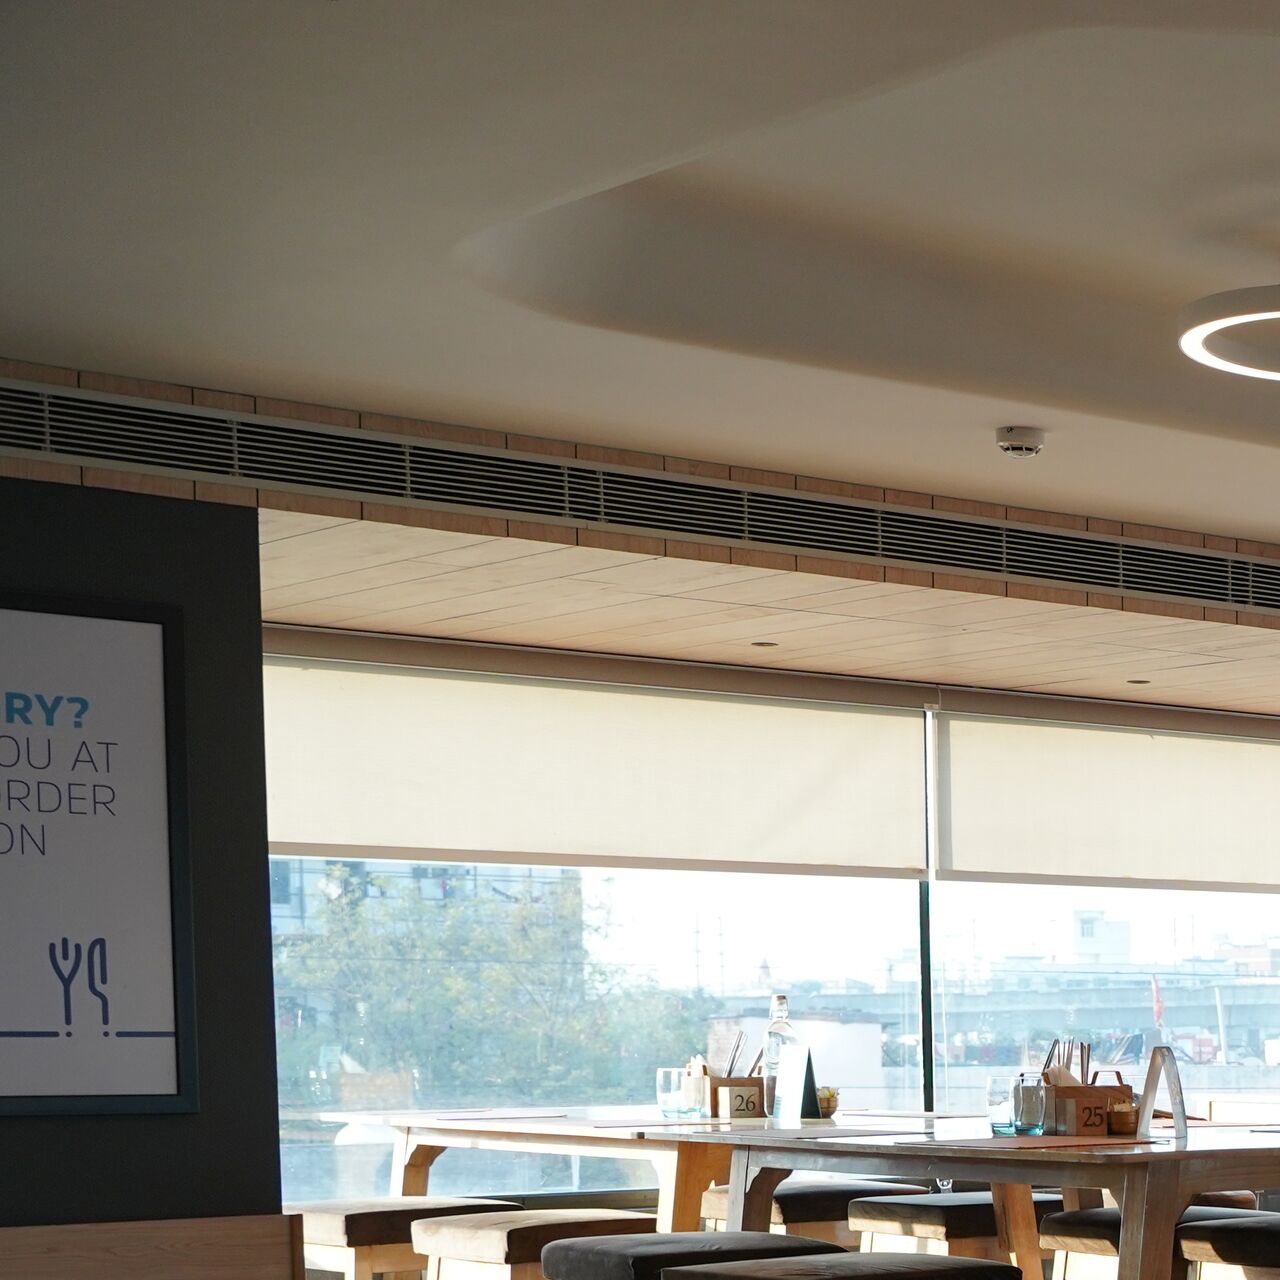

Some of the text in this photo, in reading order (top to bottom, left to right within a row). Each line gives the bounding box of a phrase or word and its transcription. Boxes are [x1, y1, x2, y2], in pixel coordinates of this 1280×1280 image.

[5, 692, 90, 729] RY?
[0, 735, 119, 774] OU AT
[0, 779, 116, 817] RDER
[735, 1094, 756, 1112] 26
[1082, 1106, 1105, 1127] 25
